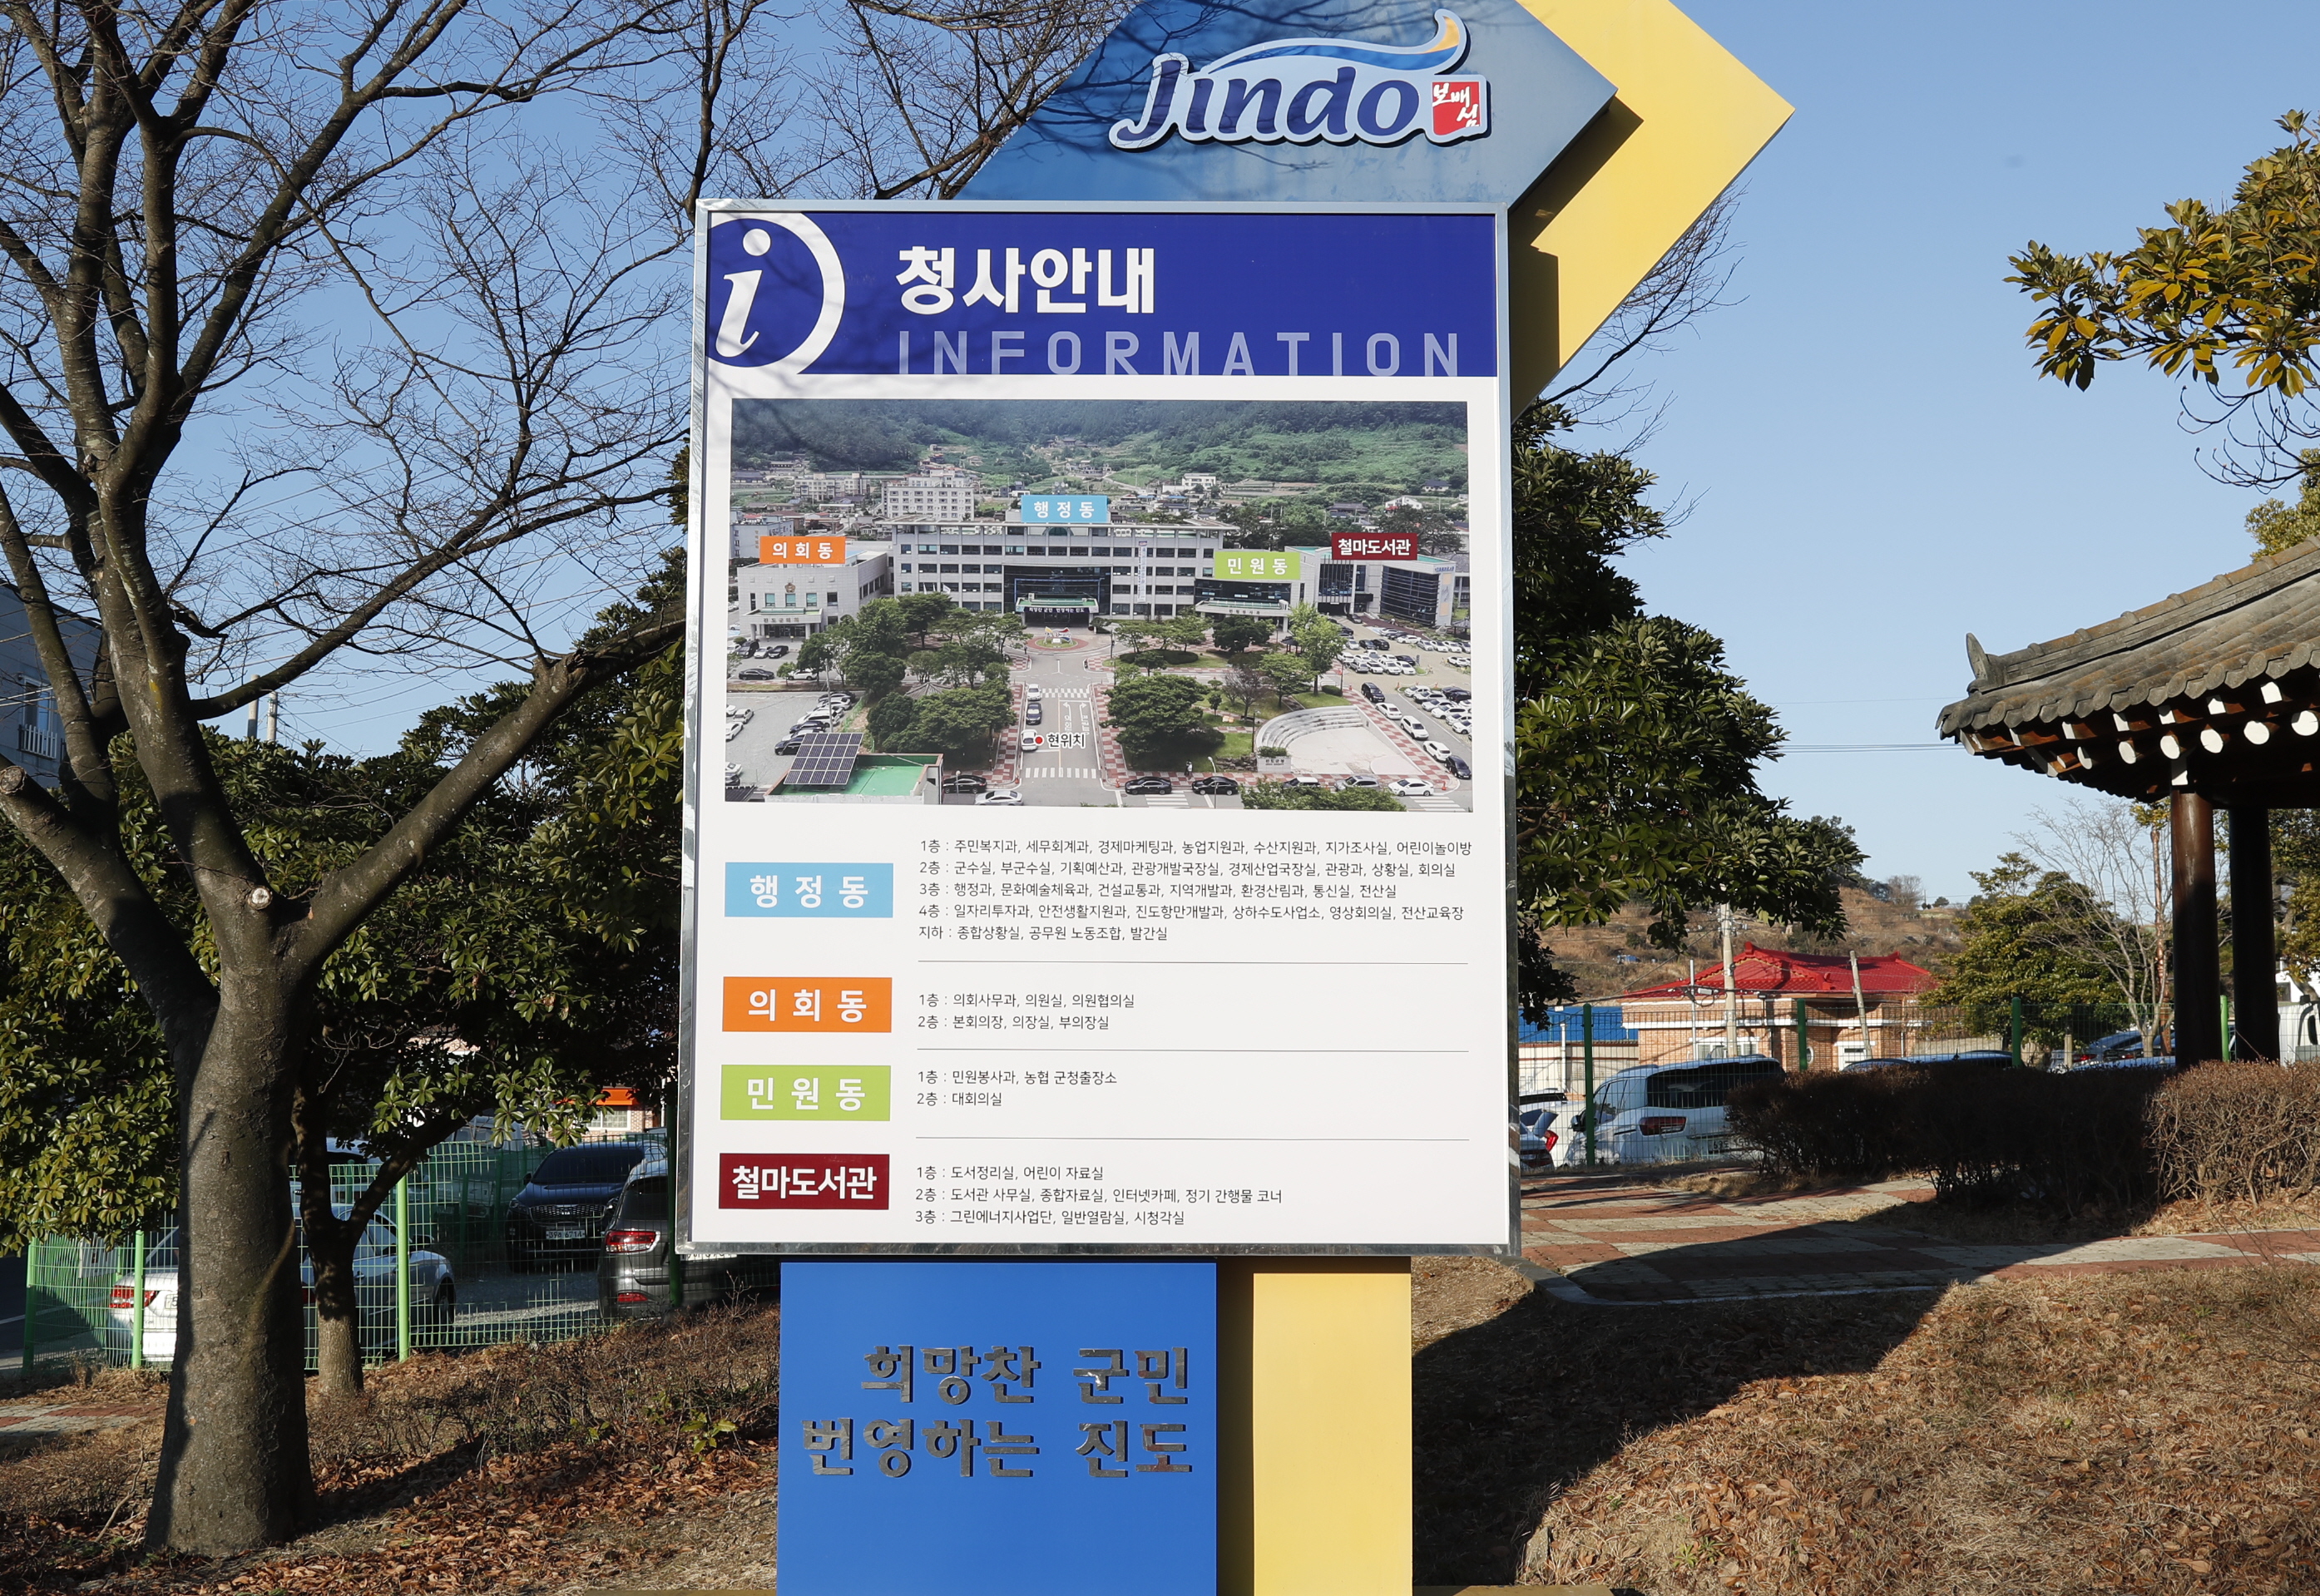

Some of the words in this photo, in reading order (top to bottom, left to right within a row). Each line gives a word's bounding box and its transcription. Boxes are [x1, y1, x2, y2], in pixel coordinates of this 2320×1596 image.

[1116, 59, 1420, 141] Jindo
[895, 245, 1155, 315] 청사안내
[899, 331, 1458, 377] INFORMATION
[1034, 501, 1095, 519] 행정동
[772, 541, 834, 560] 의회동
[1338, 538, 1412, 556] 철마도서관
[1227, 557, 1288, 576] 민원동
[1047, 734, 1085, 748] 현위치
[920, 839, 941, 854] 1층
[954, 838, 1021, 854] 주민복지과,
[1026, 839, 1092, 855] 세무회계과,
[1098, 840, 1177, 855] 경제마케팅과,
[1181, 840, 1249, 856] 농업지원과,
[1254, 841, 1320, 856] 수산지원과,
[1325, 842, 1392, 856] 지가조사실,
[1397, 842, 1472, 856] 어린이놀이방
[919, 861, 941, 875] 2층
[954, 860, 996, 876] 군수실,
[1000, 861, 1055, 876] 부군수실,
[1061, 861, 1126, 877] 기획예산과,
[1131, 862, 1224, 877] 관광개발국장실,
[1229, 862, 1320, 878] 경제산업국장실,
[1325, 863, 1367, 877] 관광과,
[1372, 863, 1413, 877] 상황실,
[1418, 864, 1456, 877] 회의실
[749, 875, 868, 908] 행정동
[919, 882, 941, 897] 3층
[954, 882, 996, 898] 행정과,
[1001, 882, 1092, 898] 문화예술체육과,
[1098, 883, 1165, 898] 건설교통과,
[1170, 883, 1236, 898] 지역개발과,
[1240, 884, 1308, 899] 환경산림과,
[1313, 885, 1354, 899] 통신실,
[1359, 885, 1397, 899] 전산실
[918, 903, 940, 918] 4층
[954, 903, 1033, 919] 일자리투자과,
[1038, 904, 1130, 920] 안전생활지원과,
[1135, 905, 1227, 921] 진도항만개발과,
[1232, 906, 1324, 921] 상하수도사업소,
[1329, 907, 1396, 921] 영상회의실,
[1402, 907, 1464, 921] 전산교육장
[918, 926, 944, 940] 지하
[957, 925, 1024, 941] 종합상황실,
[1028, 926, 1066, 941] 공무원
[1071, 926, 1125, 941] 노동조합,
[1130, 926, 1167, 941] 발간실
[748, 989, 867, 1023] 의회동
[918, 993, 939, 1008] 1층
[952, 992, 1020, 1008] 의회사무과,
[1025, 993, 1066, 1008] 의원실,
[1071, 993, 1135, 1009] 의원협의실
[918, 1015, 939, 1030] 2층
[952, 1014, 1007, 1030] 본회의장,
[1012, 1015, 1054, 1030] 의장실,
[1058, 1015, 1109, 1030] 부의장실
[917, 1070, 938, 1085] 1층
[952, 1069, 1019, 1085] 민원봉사과,
[1024, 1070, 1049, 1085] 농협
[1053, 1070, 1117, 1086] 군청출장소
[747, 1077, 865, 1112] 민원동
[917, 1091, 938, 1107] 2층
[952, 1091, 1002, 1107] 대회의실
[732, 1165, 878, 1199] 철마도서관
[916, 1165, 937, 1180] 1층
[951, 1164, 1018, 1181] 도서정리실,
[1023, 1166, 1061, 1180] 어린이
[1066, 1165, 1103, 1182] 자료실
[915, 1187, 937, 1203] 2층
[950, 1186, 989, 1202] 도서관
[992, 1188, 1035, 1203] 사무실,
[1040, 1187, 1107, 1203] 종합자료실,
[1113, 1188, 1180, 1203] 인터넷카페,
[1185, 1188, 1210, 1204] 정기
[1215, 1188, 1254, 1204] 간행물
[1257, 1189, 1282, 1203] 코너
[915, 1209, 937, 1225] 3층
[950, 1208, 1056, 1225] 그린에너지사업단,
[1061, 1209, 1129, 1226] 일반열람실,
[1134, 1210, 1185, 1226] 시청각실
[861, 1345, 1041, 1405] 희망찬
[1072, 1346, 1189, 1405] 군민
[801, 1417, 1041, 1478] 번영하는
[1075, 1420, 1193, 1478] 진도
